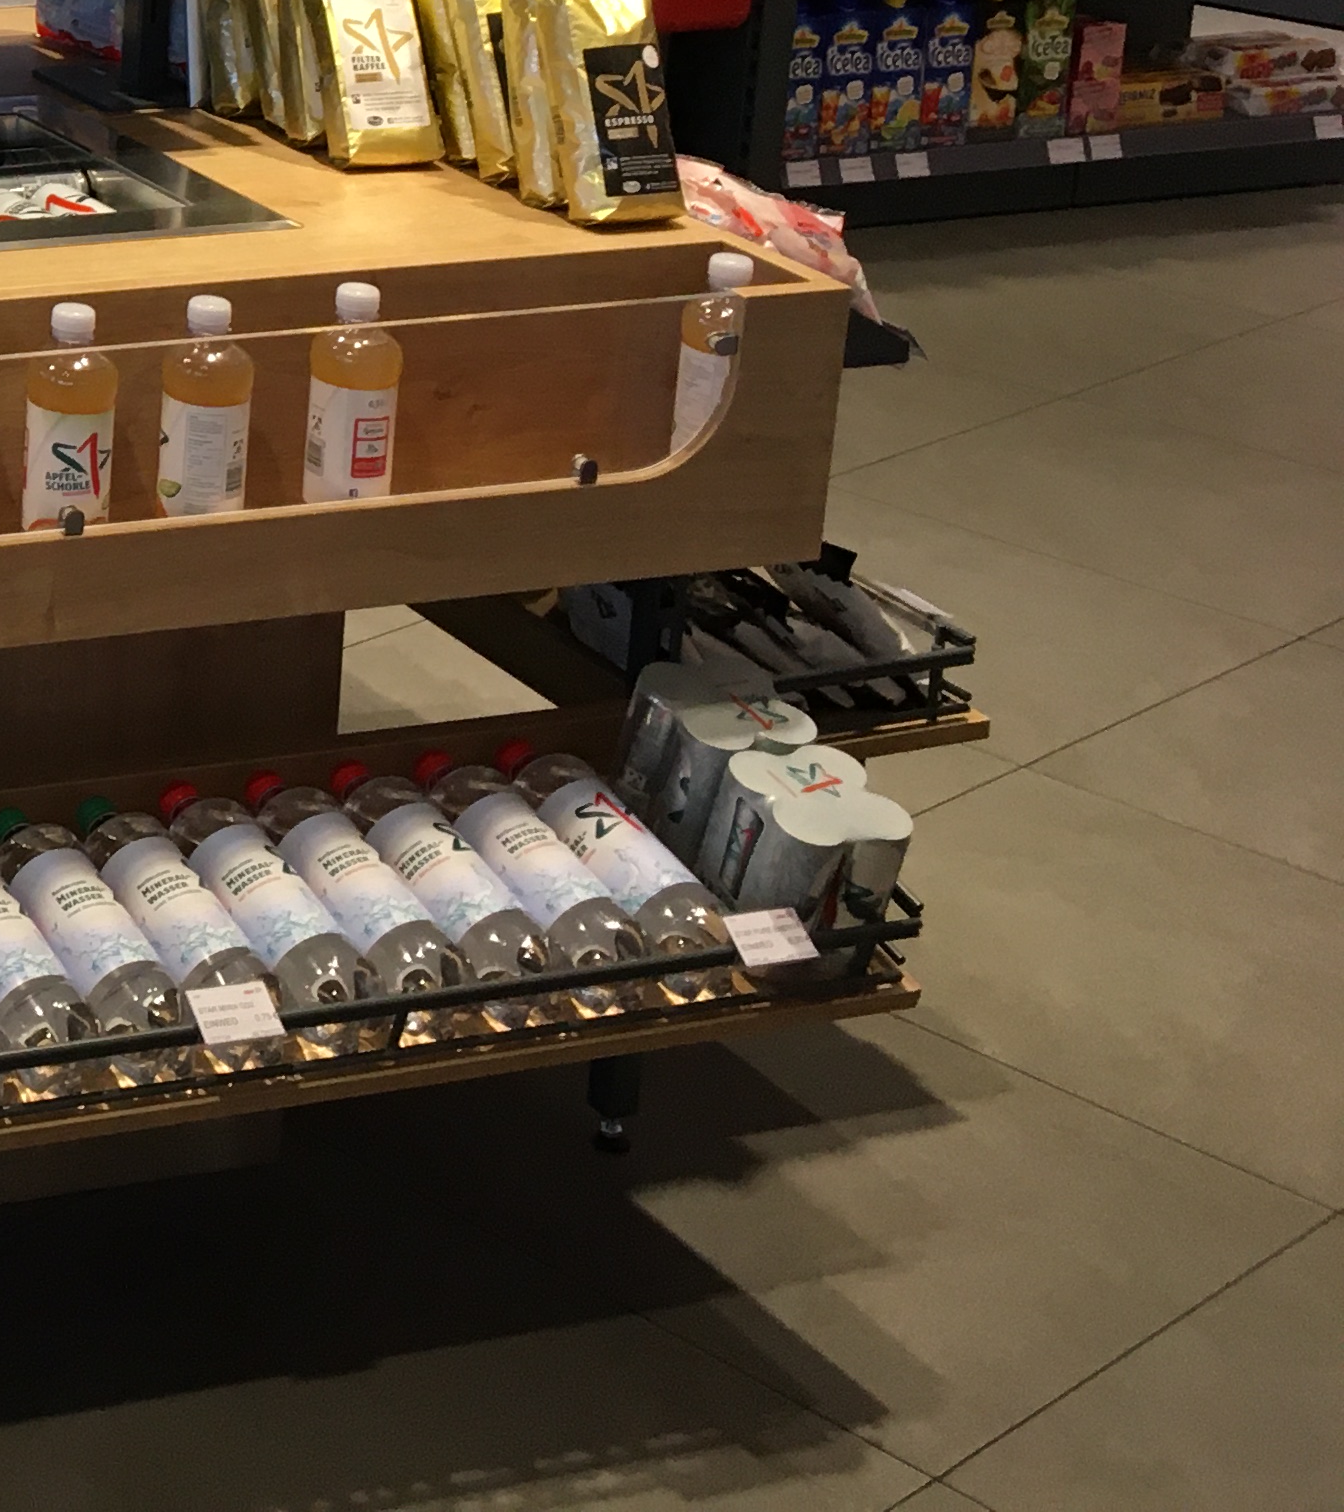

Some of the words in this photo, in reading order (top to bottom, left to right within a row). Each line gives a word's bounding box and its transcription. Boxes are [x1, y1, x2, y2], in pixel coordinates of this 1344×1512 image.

[351, 55, 381, 64] FILTER
[353, 62, 386, 71] KAFFEE
[605, 115, 655, 127] ESPRESSO
[45, 471, 83, 482] APFEL-
[45, 480, 91, 493] SCHORLE
[501, 825, 549, 847] MINERAL-
[506, 833, 549, 855] WASSER
[398, 838, 445, 873] MINERAL-
[403, 849, 443, 880] WASSER
[141, 874, 192, 898] MINERAL-
[226, 861, 274, 889] MINERAL-
[232, 869, 272, 896] WASSER
[146, 881, 189, 905] WASSER
